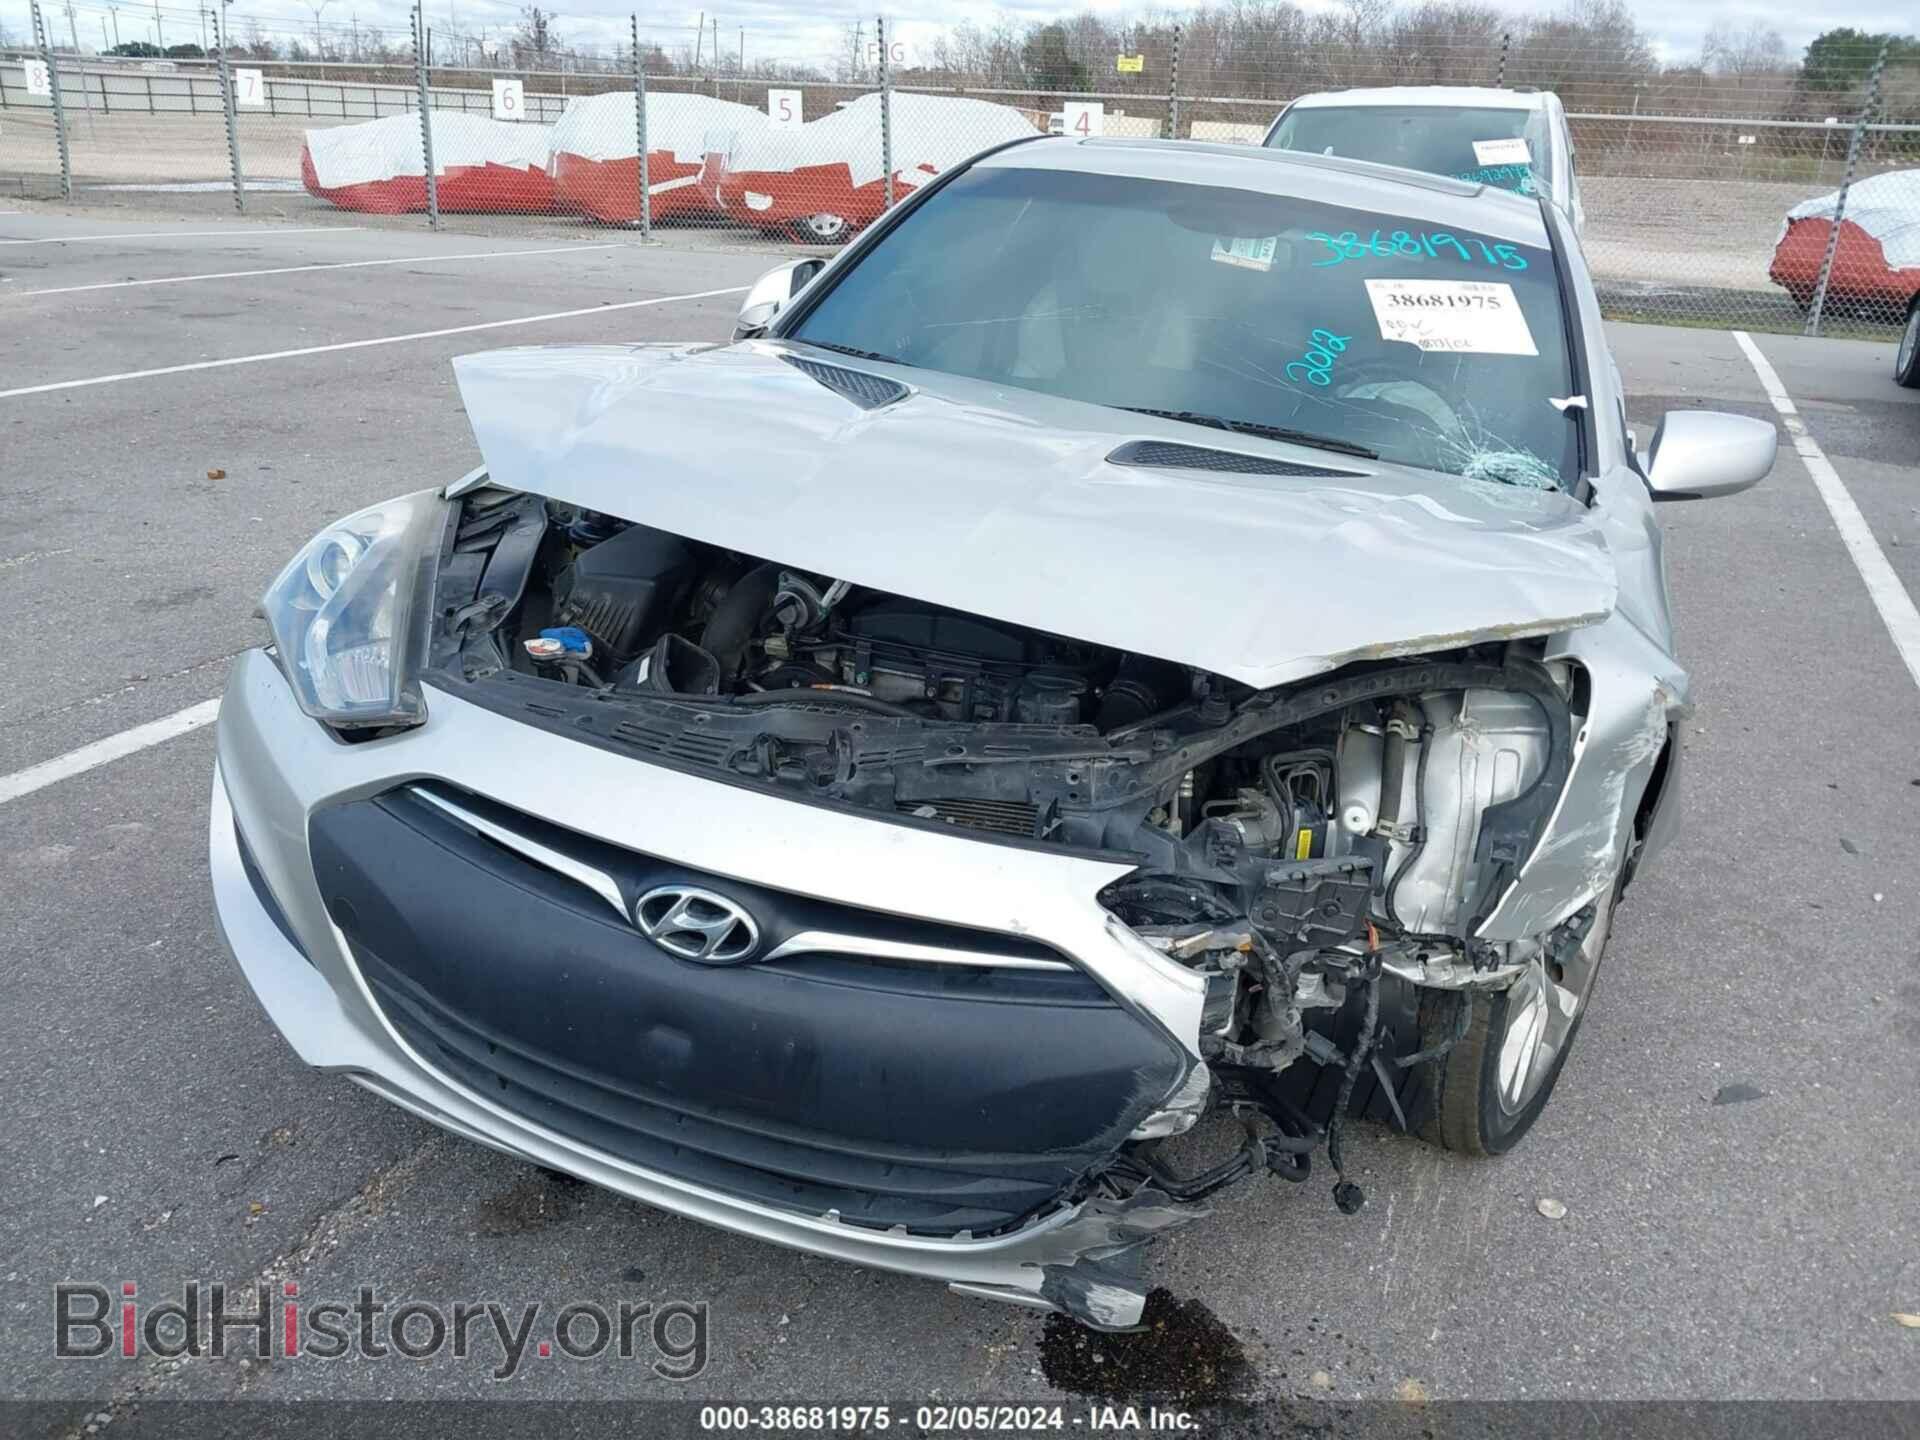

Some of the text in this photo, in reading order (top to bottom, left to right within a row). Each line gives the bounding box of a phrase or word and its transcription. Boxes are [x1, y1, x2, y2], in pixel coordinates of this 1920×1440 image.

[33, 68, 43, 88] 8
[244, 76, 255, 97] 7
[503, 88, 514, 110] 6
[780, 98, 792, 121] 5
[1074, 111, 1091, 137] 4
[1305, 230, 1528, 270] 38681975
[1387, 292, 1502, 310] 38681975
[1286, 329, 1353, 386] 2012
